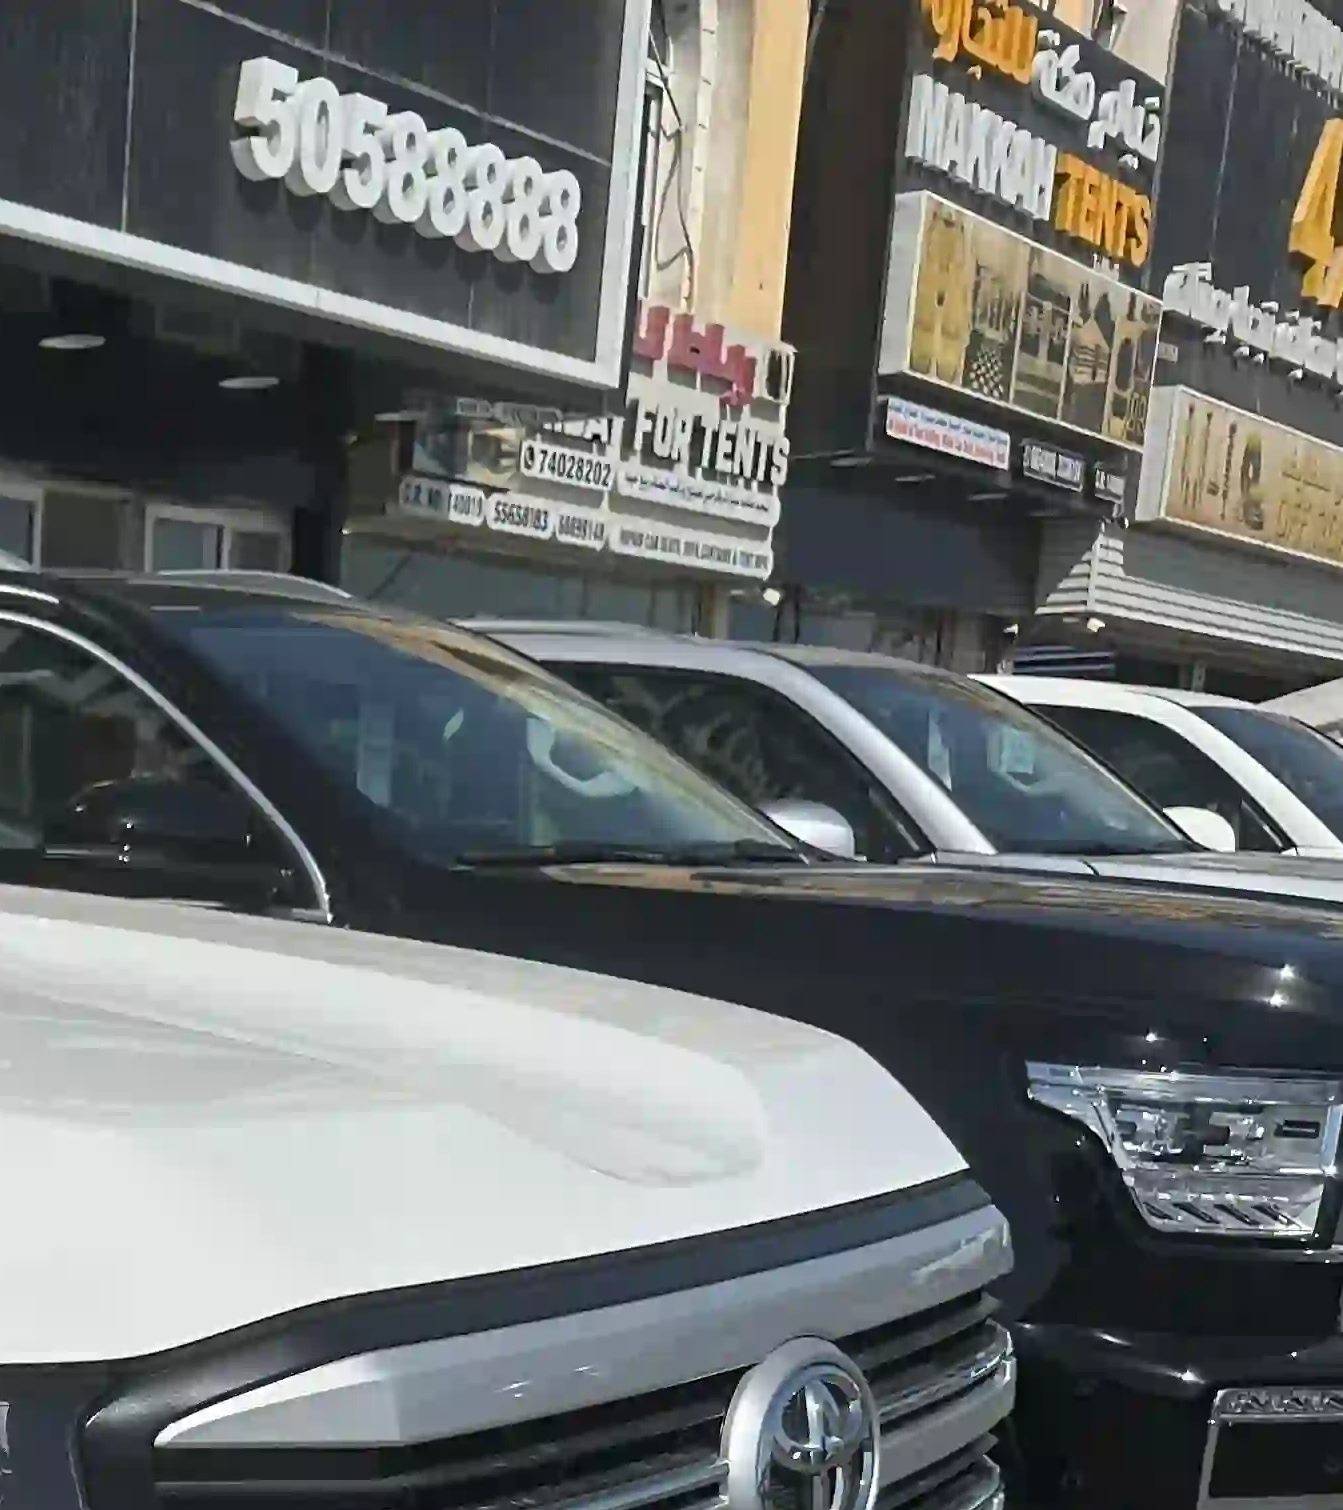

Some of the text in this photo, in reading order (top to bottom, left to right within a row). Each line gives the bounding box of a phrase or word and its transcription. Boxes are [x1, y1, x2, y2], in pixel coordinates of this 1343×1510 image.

[229, 56, 582, 273] 50588888
[905, 73, 1151, 268] MAKKAH TENTS
[538, 449, 612, 487] 74028202
[634, 400, 694, 462] FOR
[696, 412, 790, 487] TENTS
